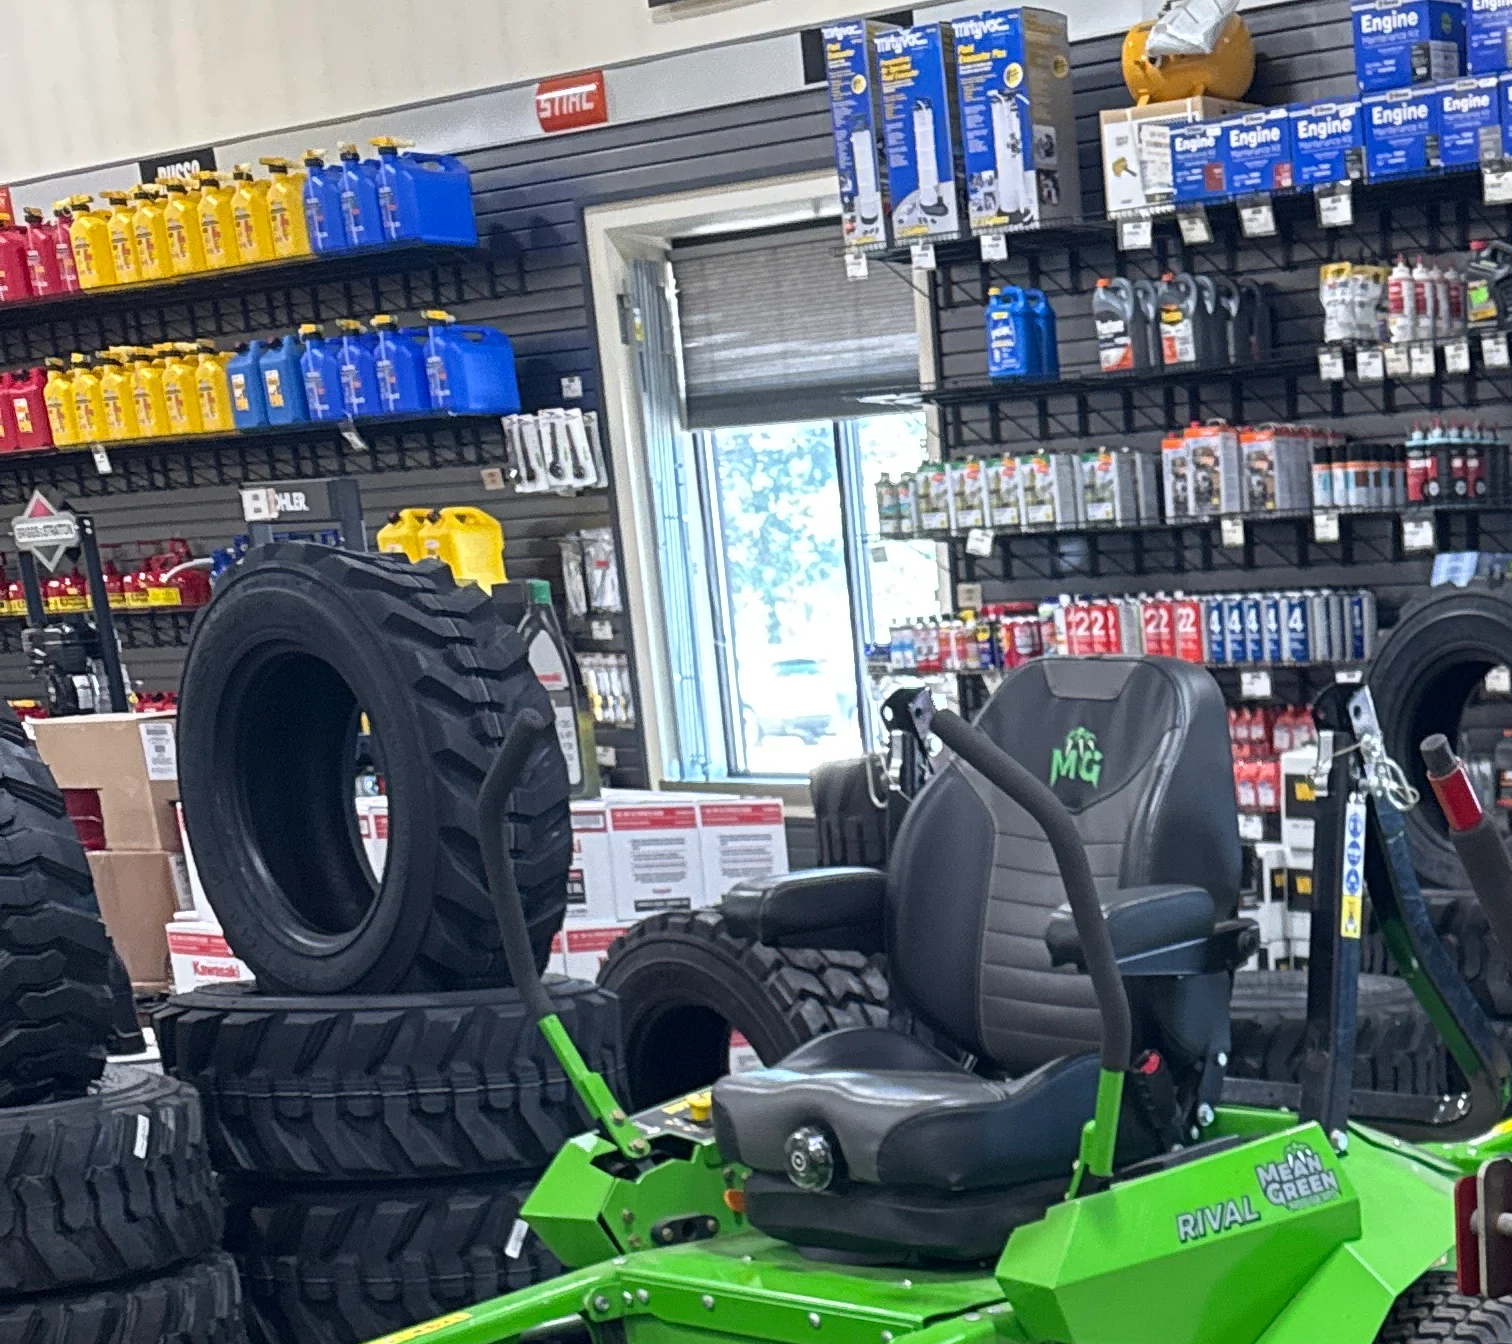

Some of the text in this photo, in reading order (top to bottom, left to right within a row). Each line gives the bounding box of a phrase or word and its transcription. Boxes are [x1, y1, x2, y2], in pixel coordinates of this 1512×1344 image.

[1360, 11, 1419, 33] Engine
[1372, 103, 1429, 126] Engine
[1443, 94, 1490, 113] Engine
[1230, 126, 1280, 148] Engine
[1298, 117, 1352, 139] Engine
[1175, 136, 1215, 152] Engine
[1050, 748, 1104, 788] MG
[1256, 1154, 1322, 1189] MEAN
[1265, 1171, 1339, 1205] GREEN
[1177, 1196, 1260, 1242] RIVAL
